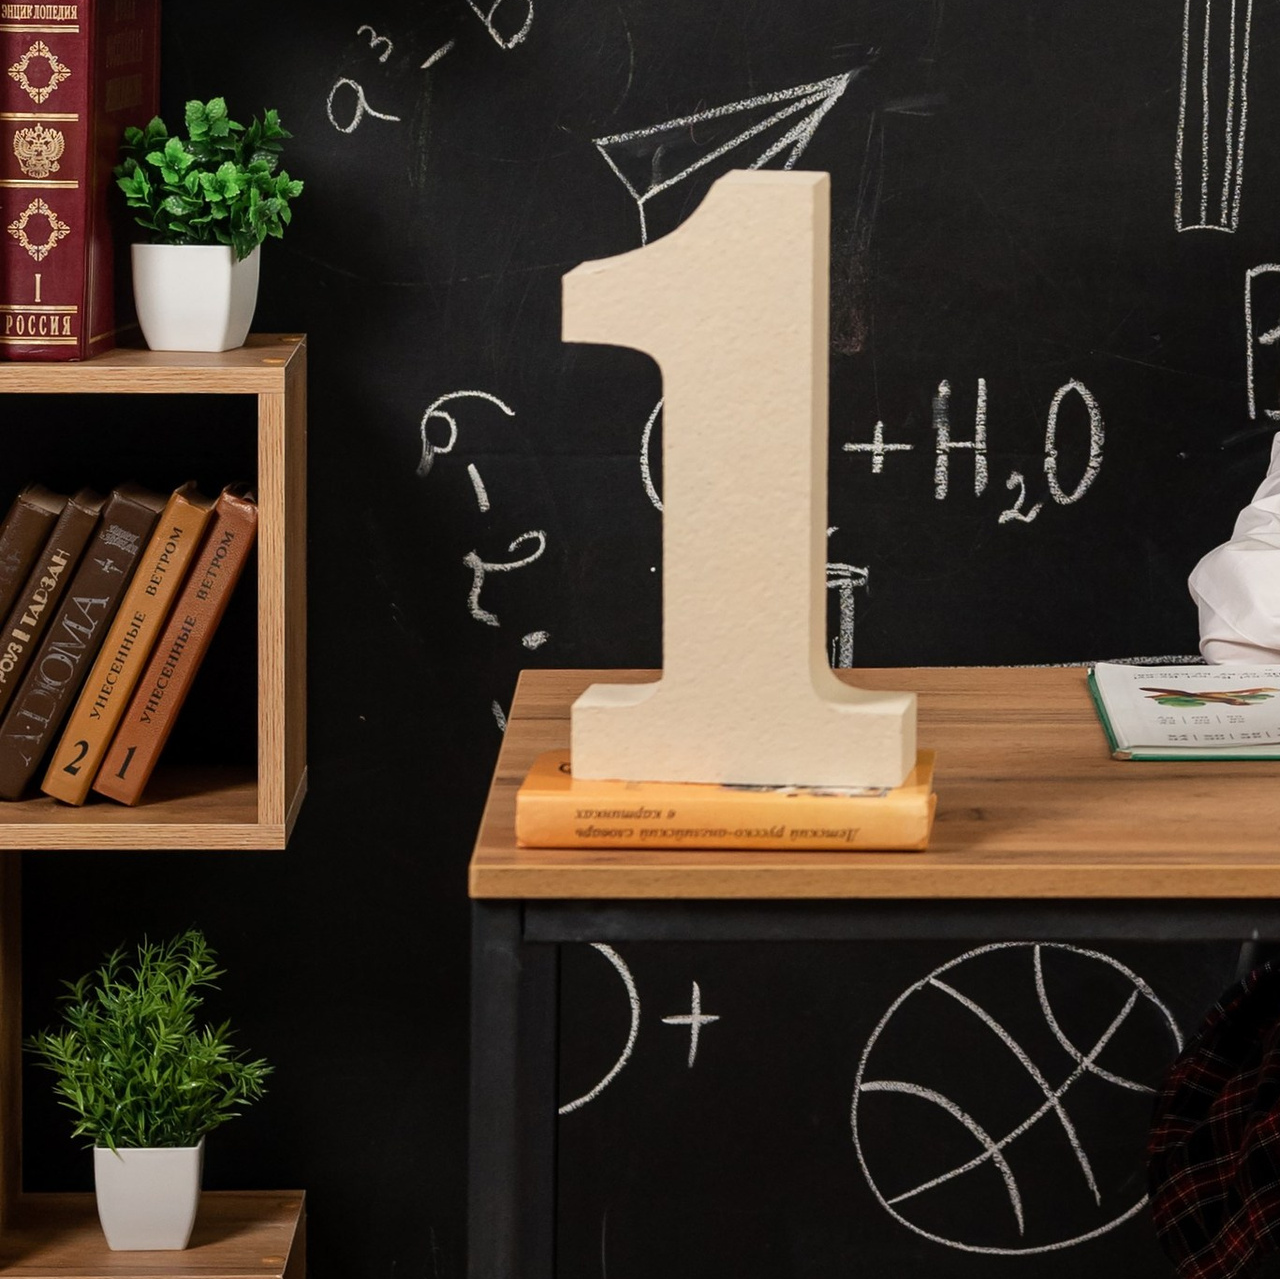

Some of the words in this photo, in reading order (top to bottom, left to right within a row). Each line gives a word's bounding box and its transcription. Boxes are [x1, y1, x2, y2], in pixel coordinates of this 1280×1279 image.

[1, 4, 78, 20] ЭНЦИКЛОПЕДИЯ
[5, 314, 72, 336] РОССИЯ
[90, 610, 146, 720] УНЕСЕННЫЕ
[145, 526, 183, 597] ВЕТРОМ
[140, 615, 197, 724] УНЕСЕННЫЕ
[196, 530, 235, 601] ВЕТРОМ
[63, 739, 90, 776] 2
[115, 746, 138, 780] 1
[575, 808, 662, 821] картинках
[575, 823, 635, 840] словарь
[790, 825, 860, 842] Детский
